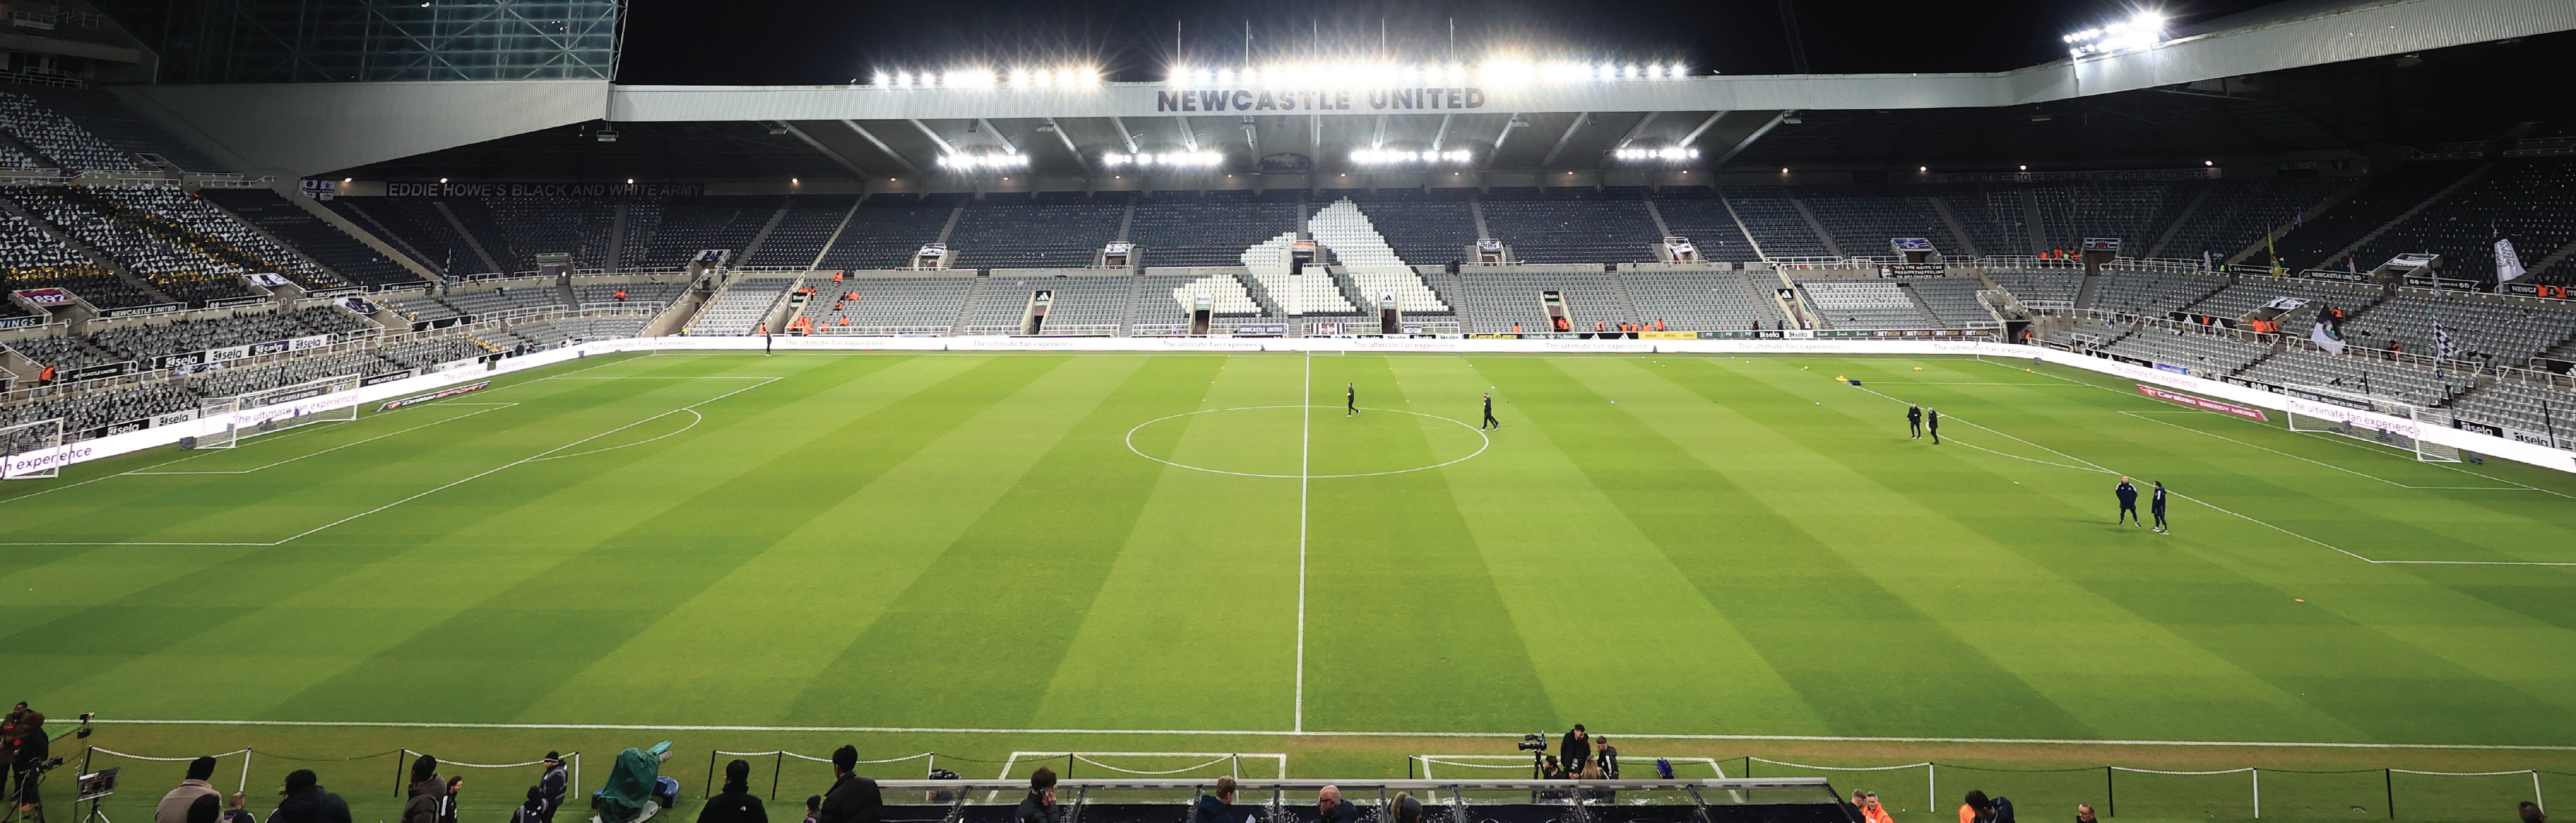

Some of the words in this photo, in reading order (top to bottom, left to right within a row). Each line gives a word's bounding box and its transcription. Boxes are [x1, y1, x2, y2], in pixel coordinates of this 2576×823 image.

[1158, 90, 1350, 111] NEWCASTLE
[1369, 88, 1485, 109] UNITED
[2018, 173, 2029, 181] TO
[2122, 170, 2146, 180] HERE
[2150, 170, 2162, 179] TO
[389, 183, 439, 196] EDDIE
[443, 183, 506, 196] HOWE'S
[512, 184, 566, 196] BLACK
[571, 184, 604, 196] AND
[610, 184, 656, 196] WHITE
[660, 184, 701, 196] ARMY
[111, 308, 152, 317] NEWCASTLE
[153, 306, 176, 314] UNITED
[264, 343, 283, 354] sela
[304, 338, 321, 348] sela
[222, 349, 242, 359] sela
[2002, 348, 2044, 356] experience
[175, 355, 198, 366] sela
[368, 376, 393, 385] NEWCASTLE
[2112, 364, 2122, 373] The
[2124, 368, 2147, 378] ultimate
[2150, 372, 2160, 380] fan
[2161, 375, 2198, 389] experience
[332, 382, 357, 393] BETMG
[270, 393, 300, 403] NECASTLE
[254, 408, 292, 421] ultimate
[310, 395, 357, 409] experience
[2157, 391, 2197, 404] Carabao
[2198, 400, 2230, 412] ENERGY
[2231, 407, 2258, 418] DRINK
[2290, 400, 2306, 410] The
[2308, 404, 2344, 419] ultimate
[2347, 412, 2362, 422] fan
[169, 414, 189, 425] sela
[117, 423, 140, 434] sela
[2471, 426, 2493, 437] sela
[2524, 437, 2548, 447] sela
[16, 447, 92, 469] experence
